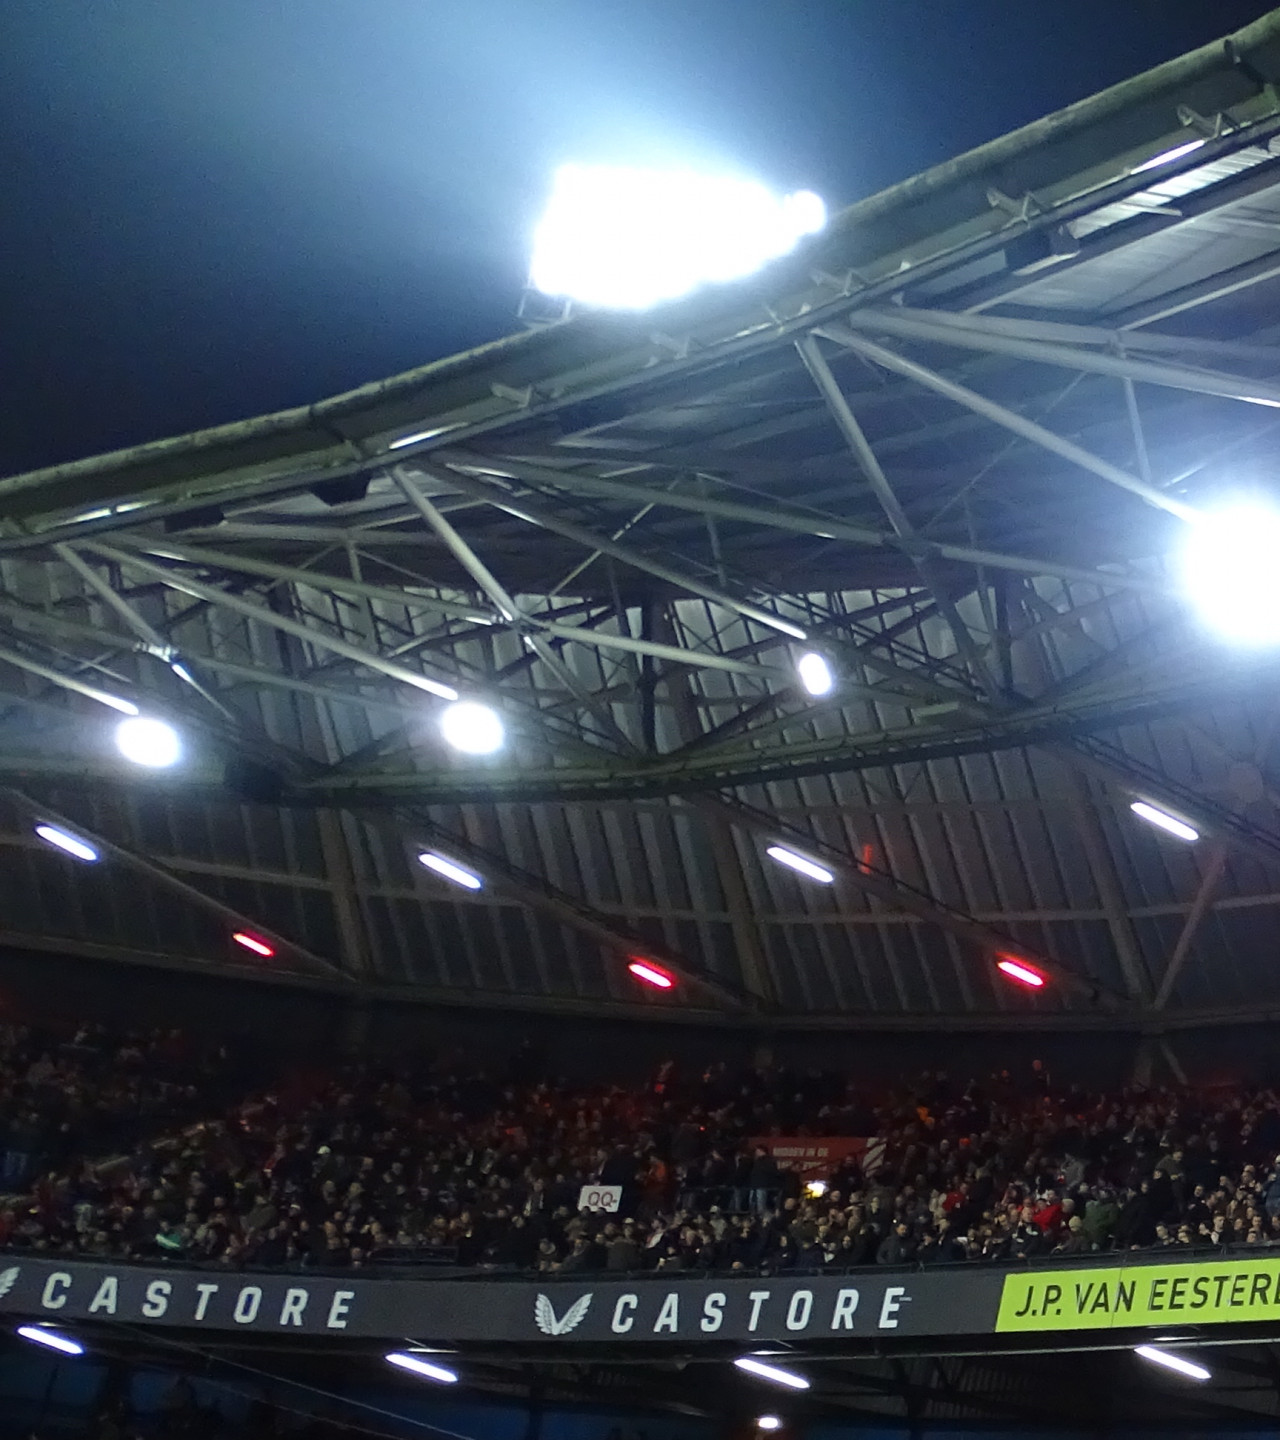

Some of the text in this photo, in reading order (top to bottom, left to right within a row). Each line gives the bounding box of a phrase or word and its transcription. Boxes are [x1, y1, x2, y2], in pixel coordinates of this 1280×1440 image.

[41, 1272, 356, 1329] CASTORE
[611, 1287, 906, 1333] CASTORE
[1014, 1284, 1062, 1318] J.P.
[1075, 1279, 1137, 1314] VAN
